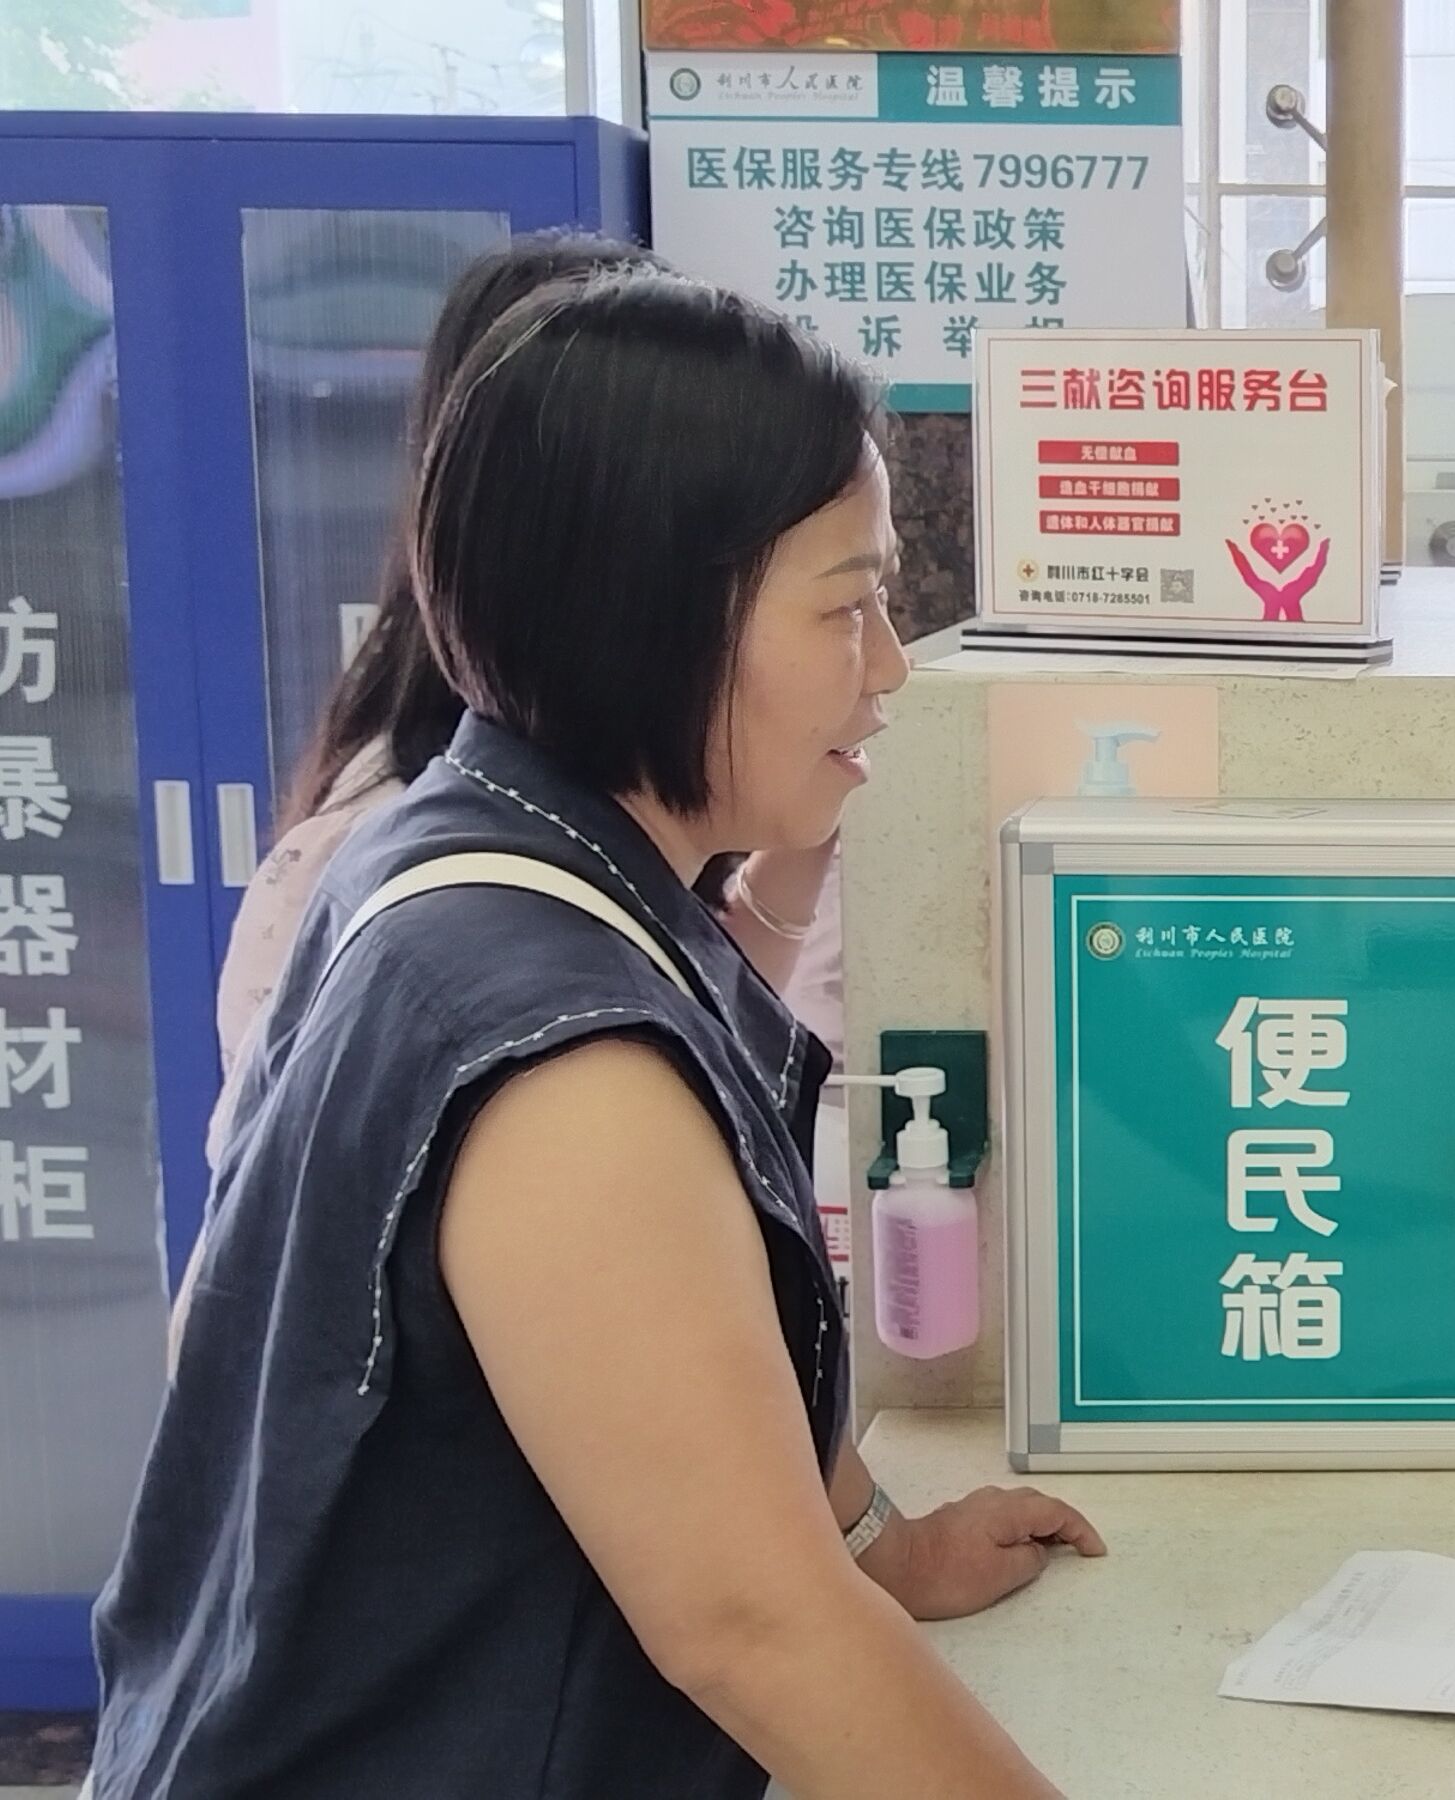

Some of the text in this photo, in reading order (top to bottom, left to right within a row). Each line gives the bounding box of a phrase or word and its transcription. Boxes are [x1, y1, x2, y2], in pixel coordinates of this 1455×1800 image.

[925, 65, 1137, 110] 温馨提示
[773, 205, 1066, 251] 咨询医保政策
[774, 259, 1067, 305] 办理医保业务
[1019, 367, 1328, 413] 三献咨询服务台
[1135, 925, 1295, 946] 利川市人民医院
[1214, 996, 1351, 1362] 便民箱
